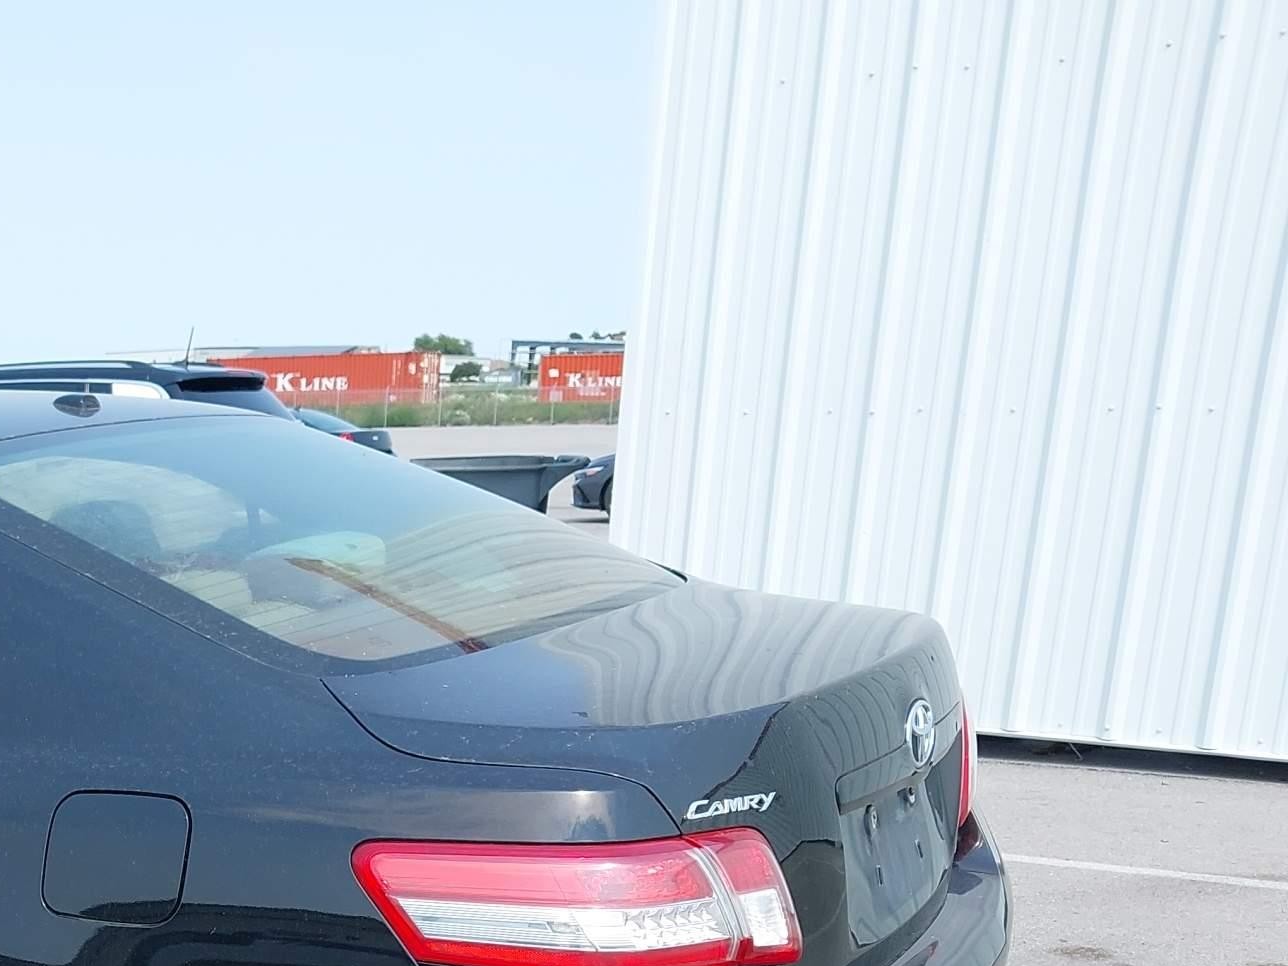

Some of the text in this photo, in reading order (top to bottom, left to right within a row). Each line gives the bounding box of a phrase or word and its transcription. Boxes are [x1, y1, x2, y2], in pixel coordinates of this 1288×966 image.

[271, 372, 349, 392] K LINE
[565, 372, 584, 388] K
